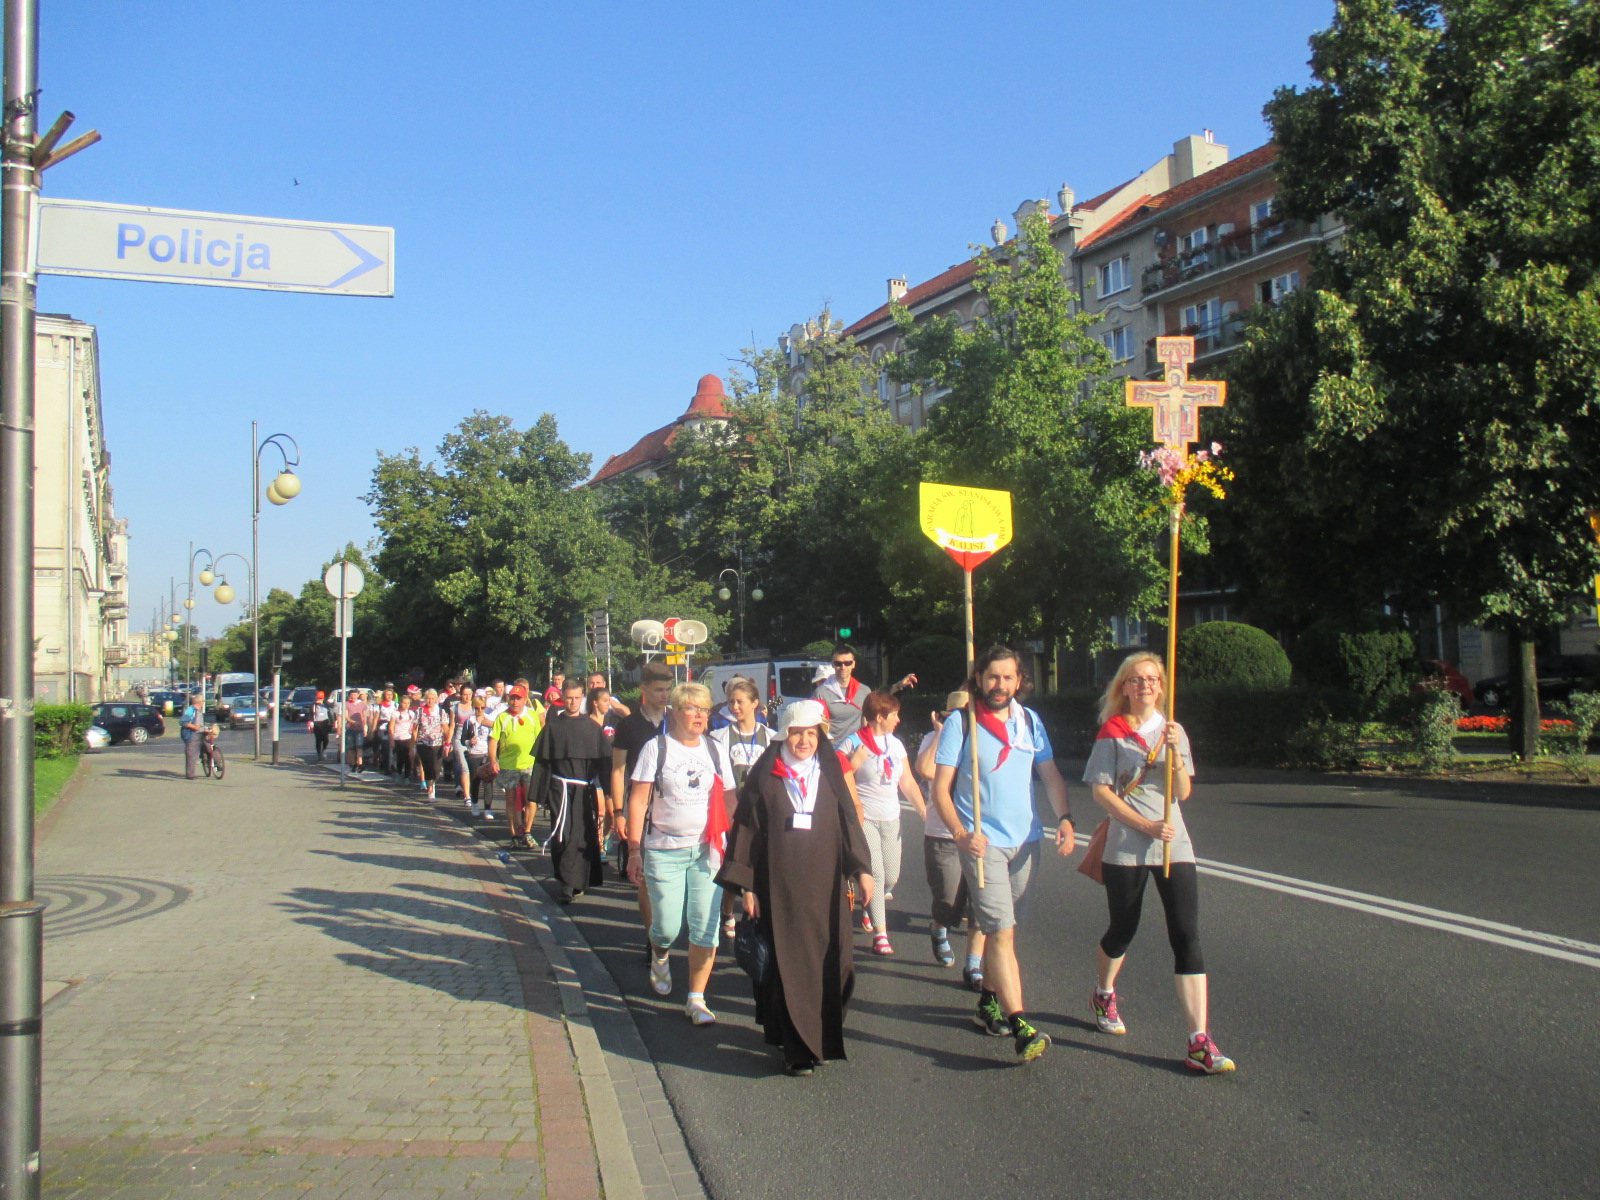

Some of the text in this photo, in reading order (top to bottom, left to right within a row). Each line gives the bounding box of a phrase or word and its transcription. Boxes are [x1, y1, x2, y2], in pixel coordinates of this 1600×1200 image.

[116, 223, 271, 278] Policja
[927, 498, 942, 532] PARAFIA
[949, 538, 986, 550] KALISZ
[664, 626, 674, 635] ST
